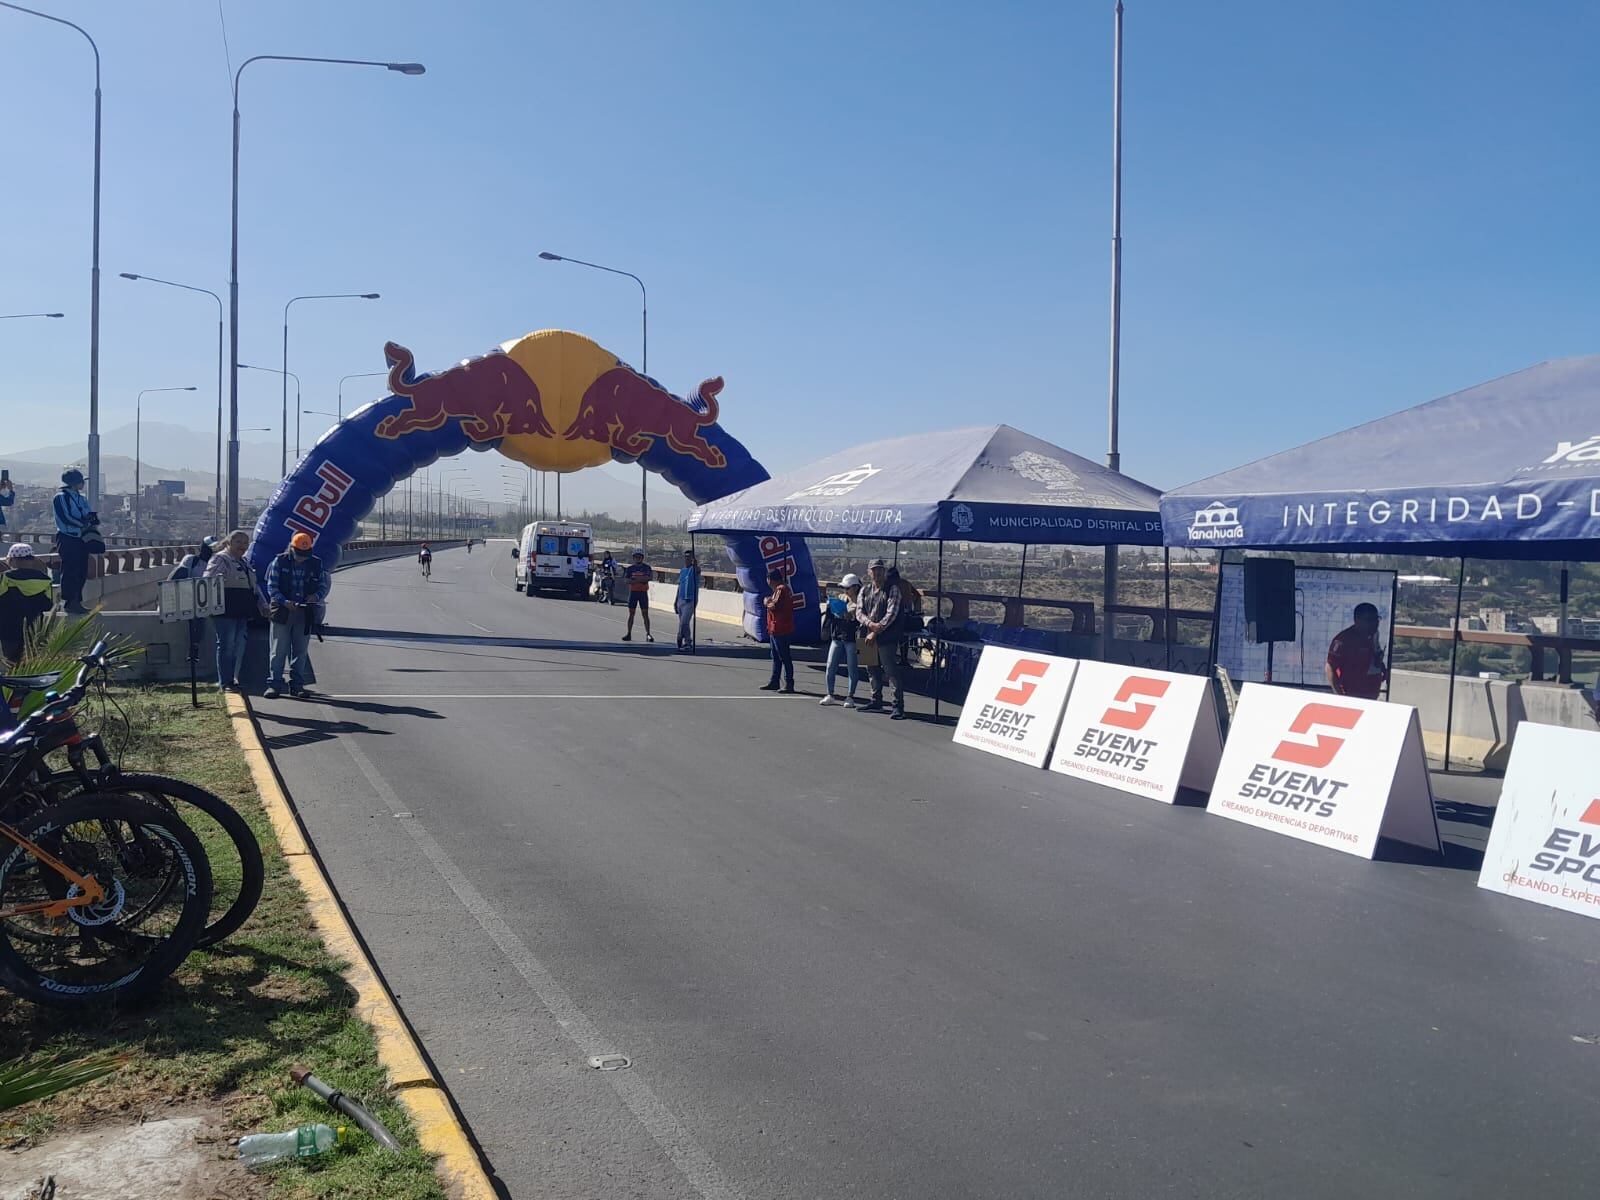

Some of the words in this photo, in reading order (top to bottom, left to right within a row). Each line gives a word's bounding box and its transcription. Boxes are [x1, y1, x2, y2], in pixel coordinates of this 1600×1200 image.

[293, 459, 355, 528] Bull
[989, 516, 1082, 529] MUNICIPALIDAD
[1088, 519, 1141, 531] DISTRITAL
[1145, 521, 1162, 532] DE
[1187, 525, 1243, 540] Yanahuara
[196, 577, 222, 607] 01
[973, 718, 1028, 741] SPORTS
[979, 704, 1036, 728] EVENT
[1081, 727, 1158, 756] EVENT
[1074, 744, 1149, 772] SPORTS
[1060, 759, 1086, 771] CREANDO
[1086, 765, 1126, 782] EXPERIENCIAS
[1126, 776, 1164, 792] DEPORTIVAS
[1248, 763, 1348, 799] EVENT
[1238, 782, 1338, 818] SPORTS
[1221, 800, 1254, 815] CREANDO
[1255, 808, 1308, 829] EXPERIENCIAS
[1308, 823, 1360, 843] DEPORTIVAS
[1503, 873, 1559, 894] CREANDO
